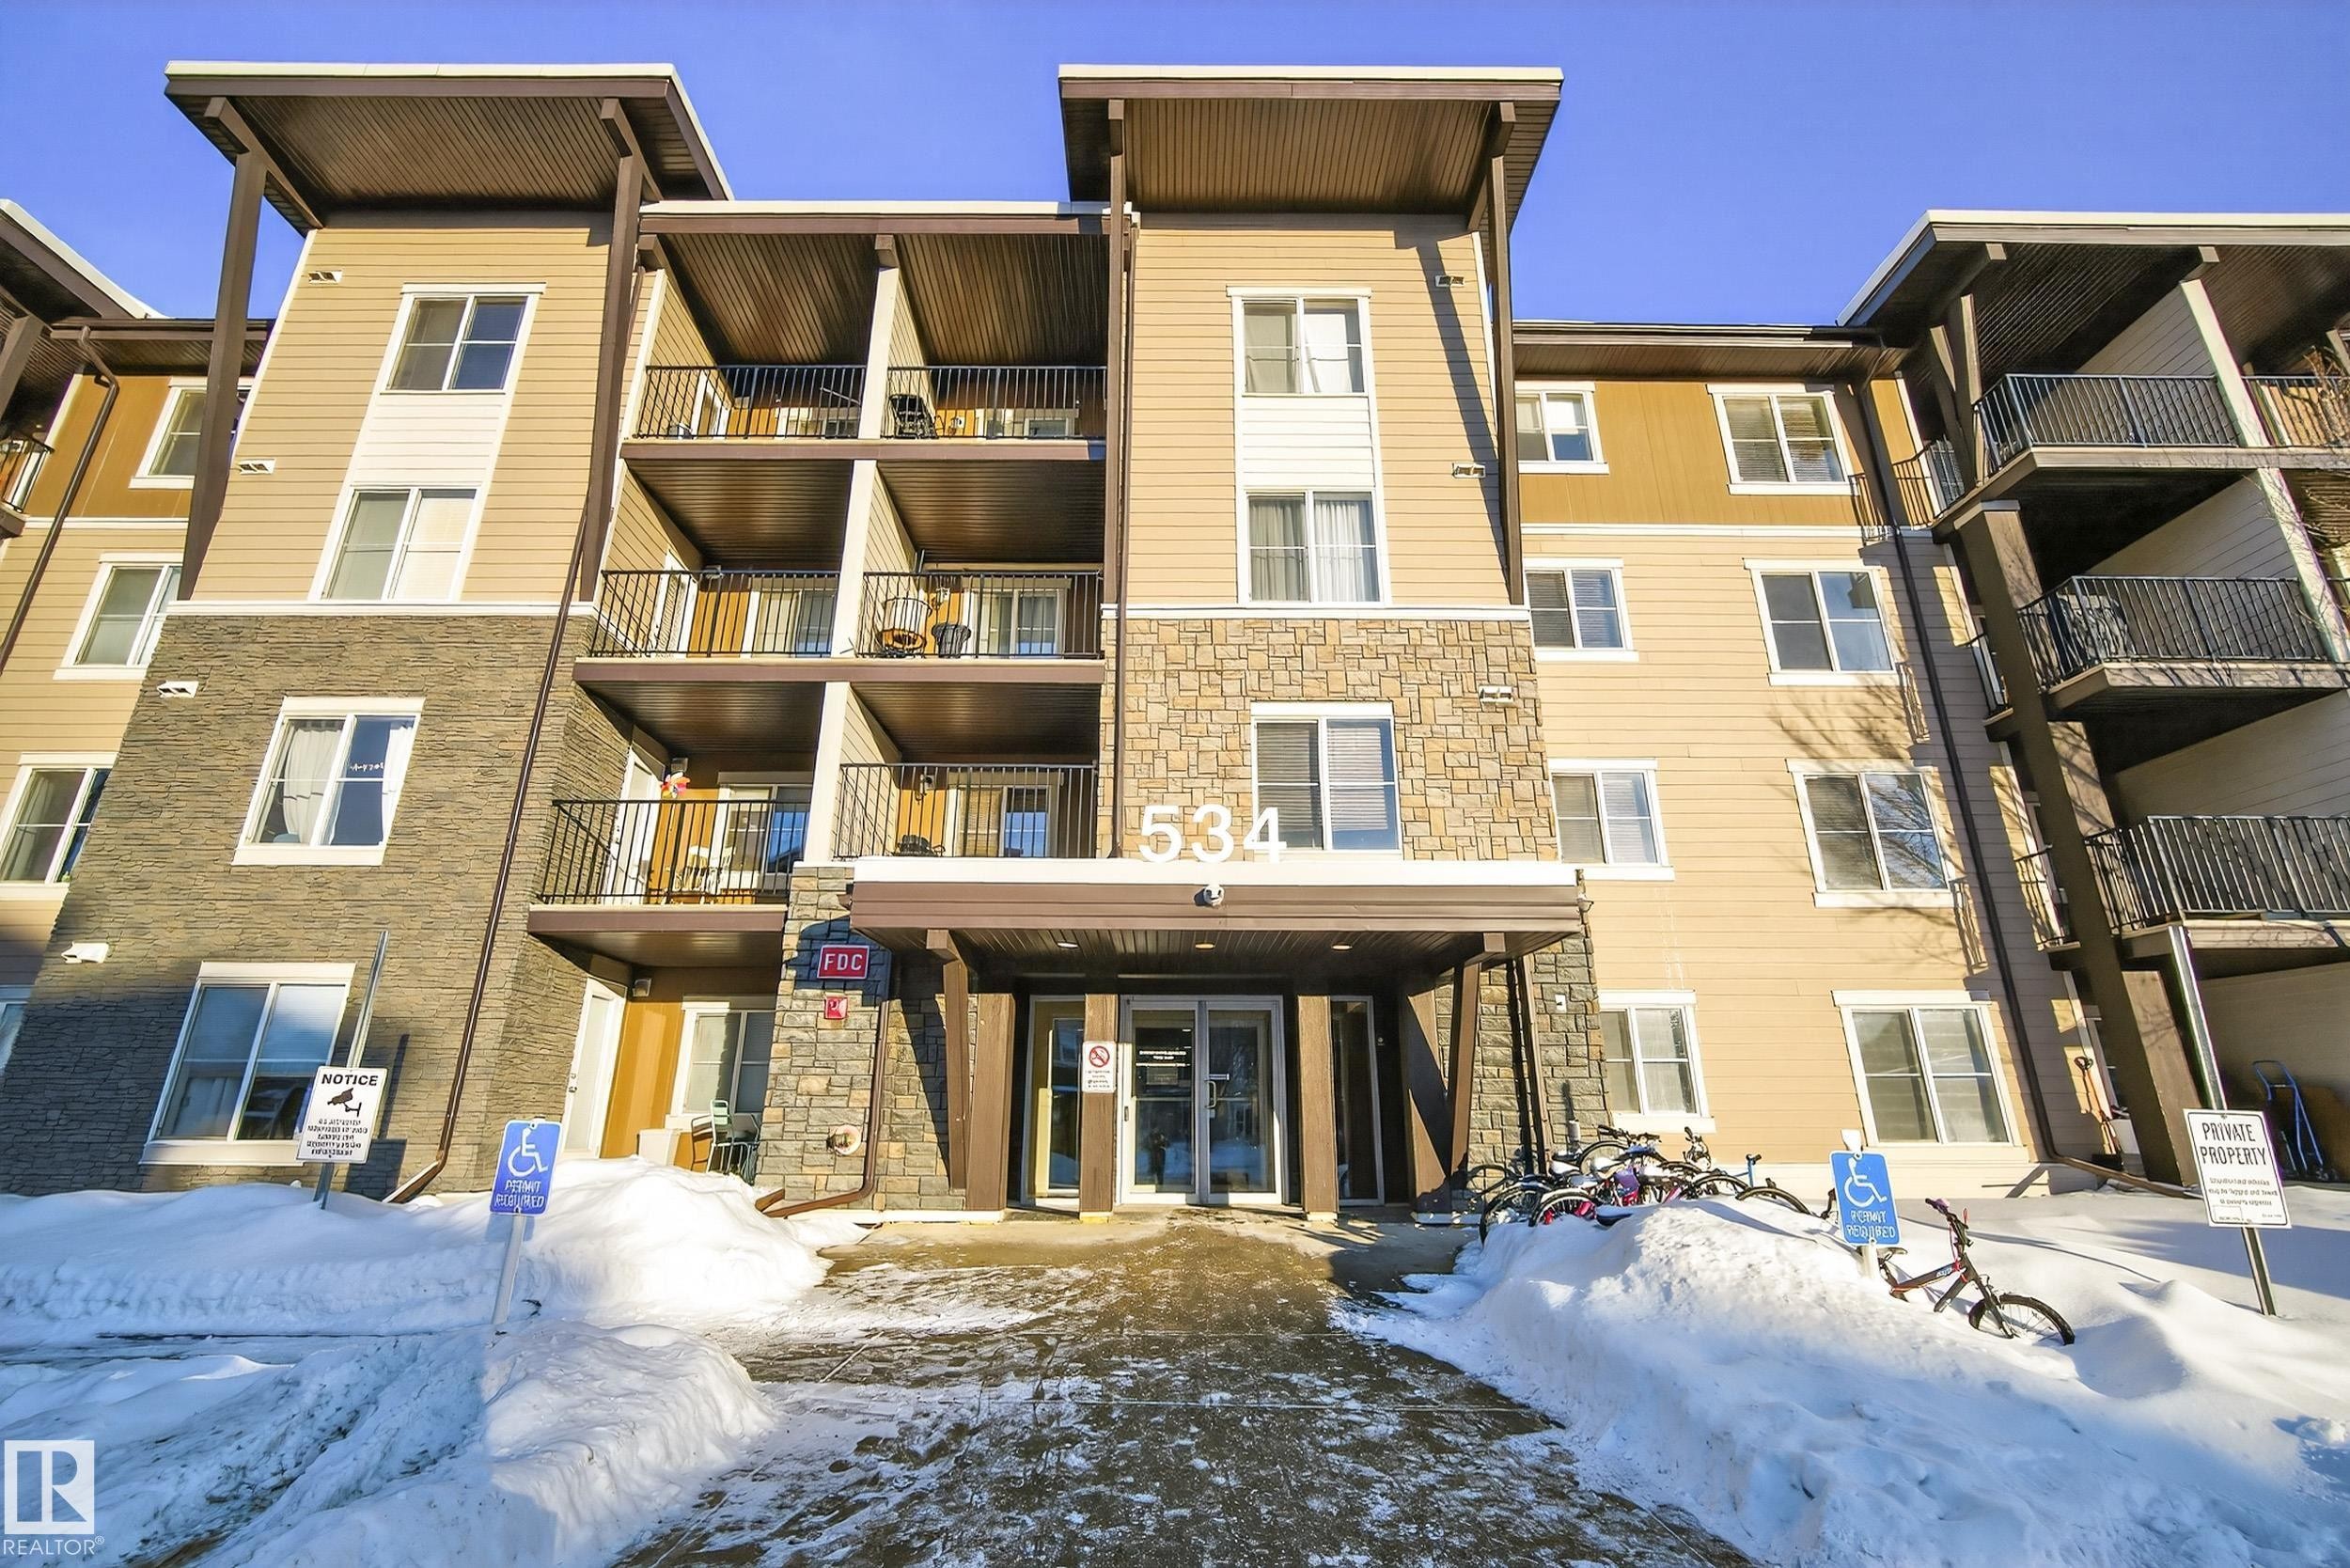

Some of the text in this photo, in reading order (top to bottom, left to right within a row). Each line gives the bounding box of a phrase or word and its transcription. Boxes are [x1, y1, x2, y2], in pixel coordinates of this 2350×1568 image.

[1138, 804, 1287, 863] 534
[823, 953, 863, 970] FDC
[321, 1074, 378, 1086] NOTICE
[2201, 1122, 2255, 1141] PRIVATE
[2200, 1146, 2266, 1165] PROPERTY
[505, 1180, 541, 1193] PERMIT
[494, 1194, 544, 1207] REQUIRED
[1851, 1211, 1886, 1223] PERMIT
[1846, 1225, 1896, 1238] REQUIRED
